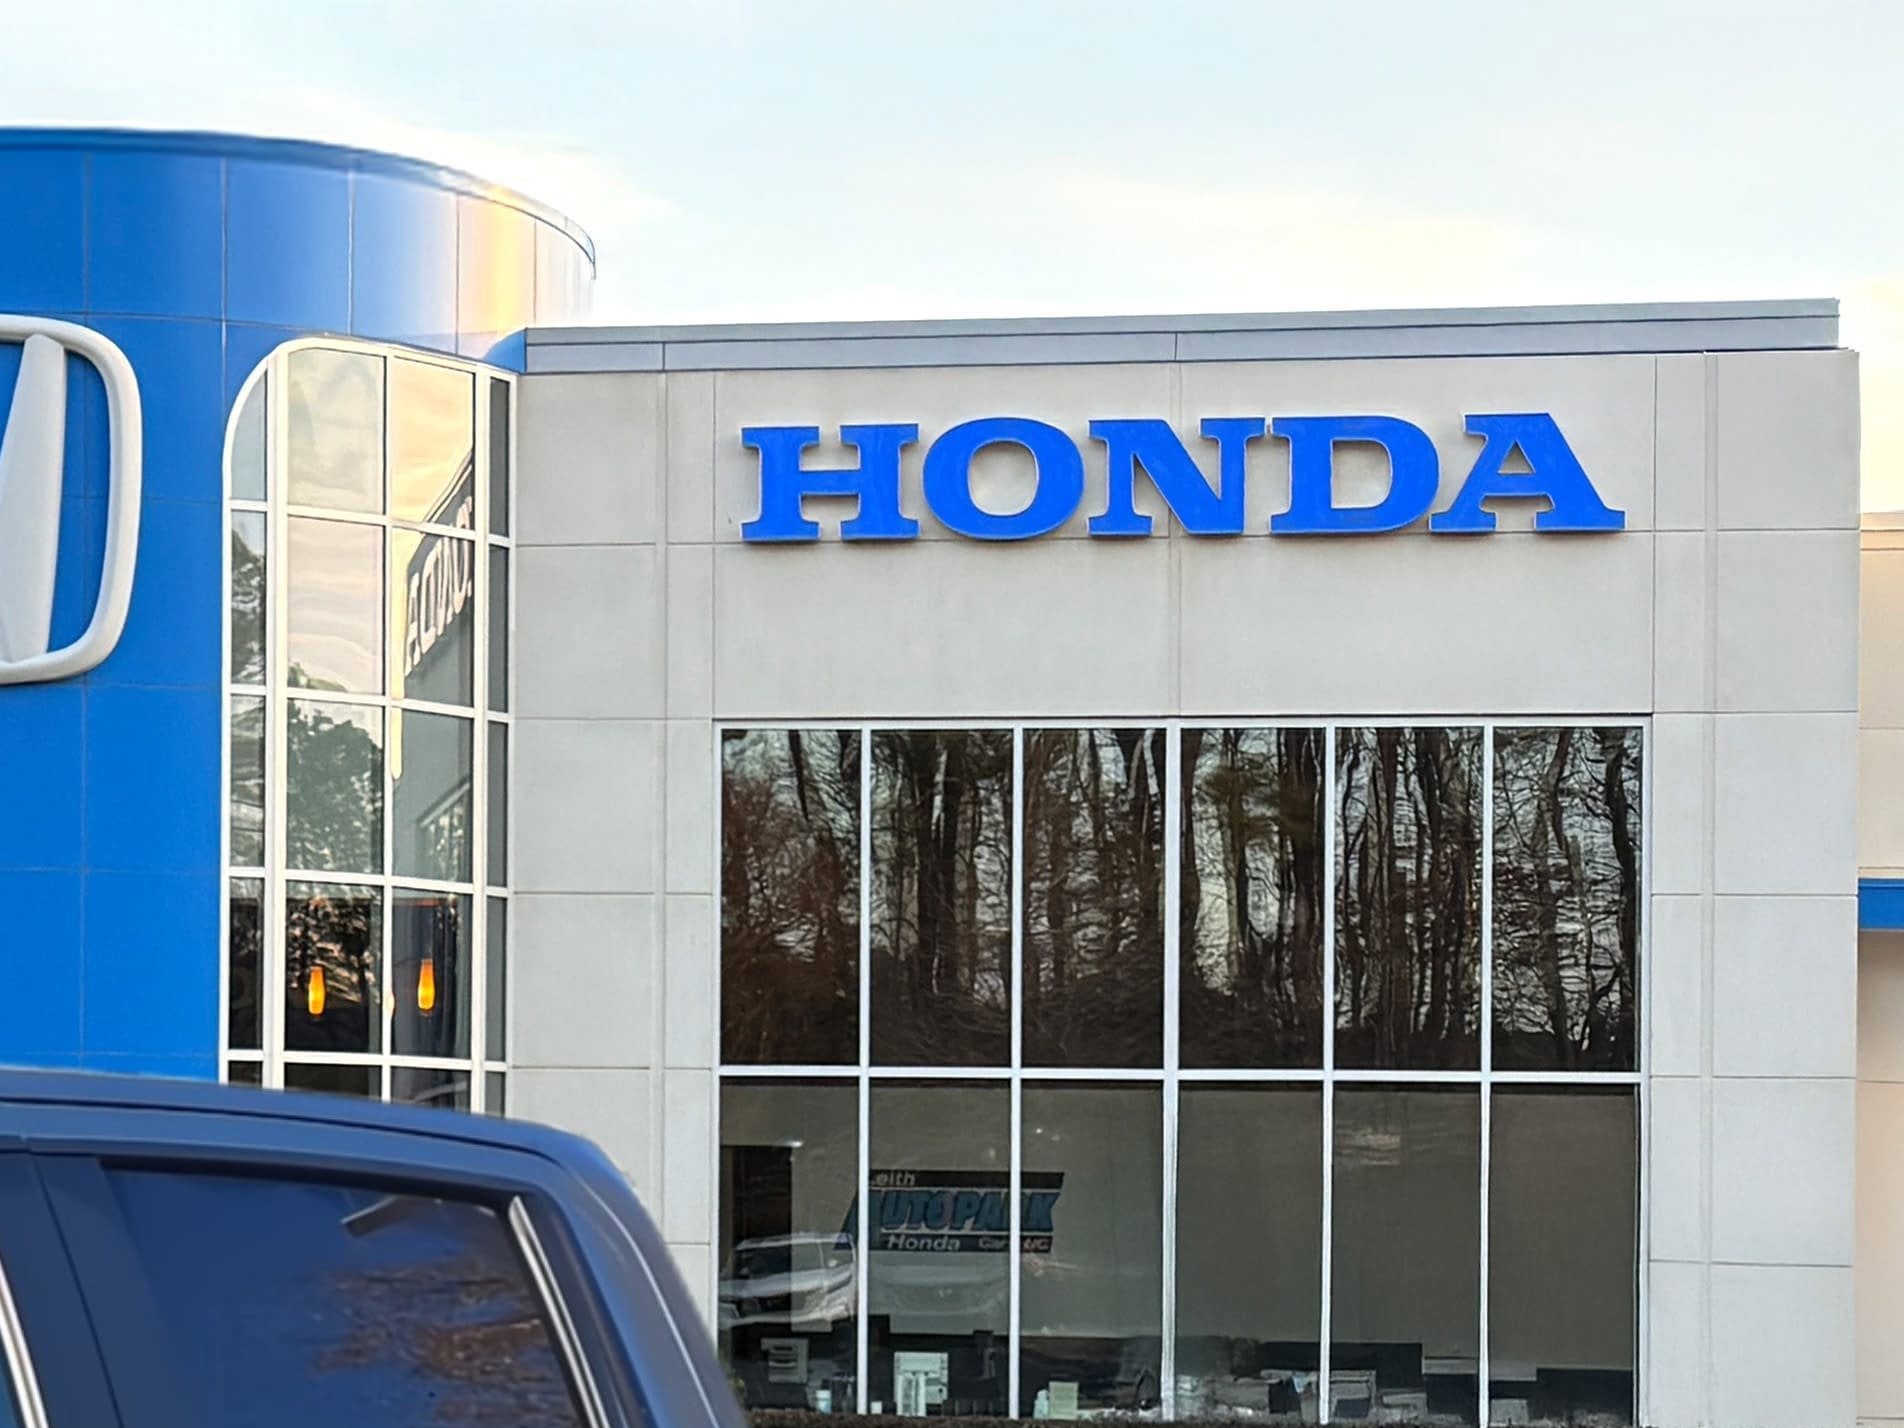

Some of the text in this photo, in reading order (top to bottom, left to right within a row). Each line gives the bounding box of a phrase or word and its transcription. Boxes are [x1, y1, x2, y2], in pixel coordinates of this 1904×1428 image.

[741, 412, 1626, 542] HONDA
[871, 1172, 916, 1187] eith
[887, 1235, 960, 1251] Honda
